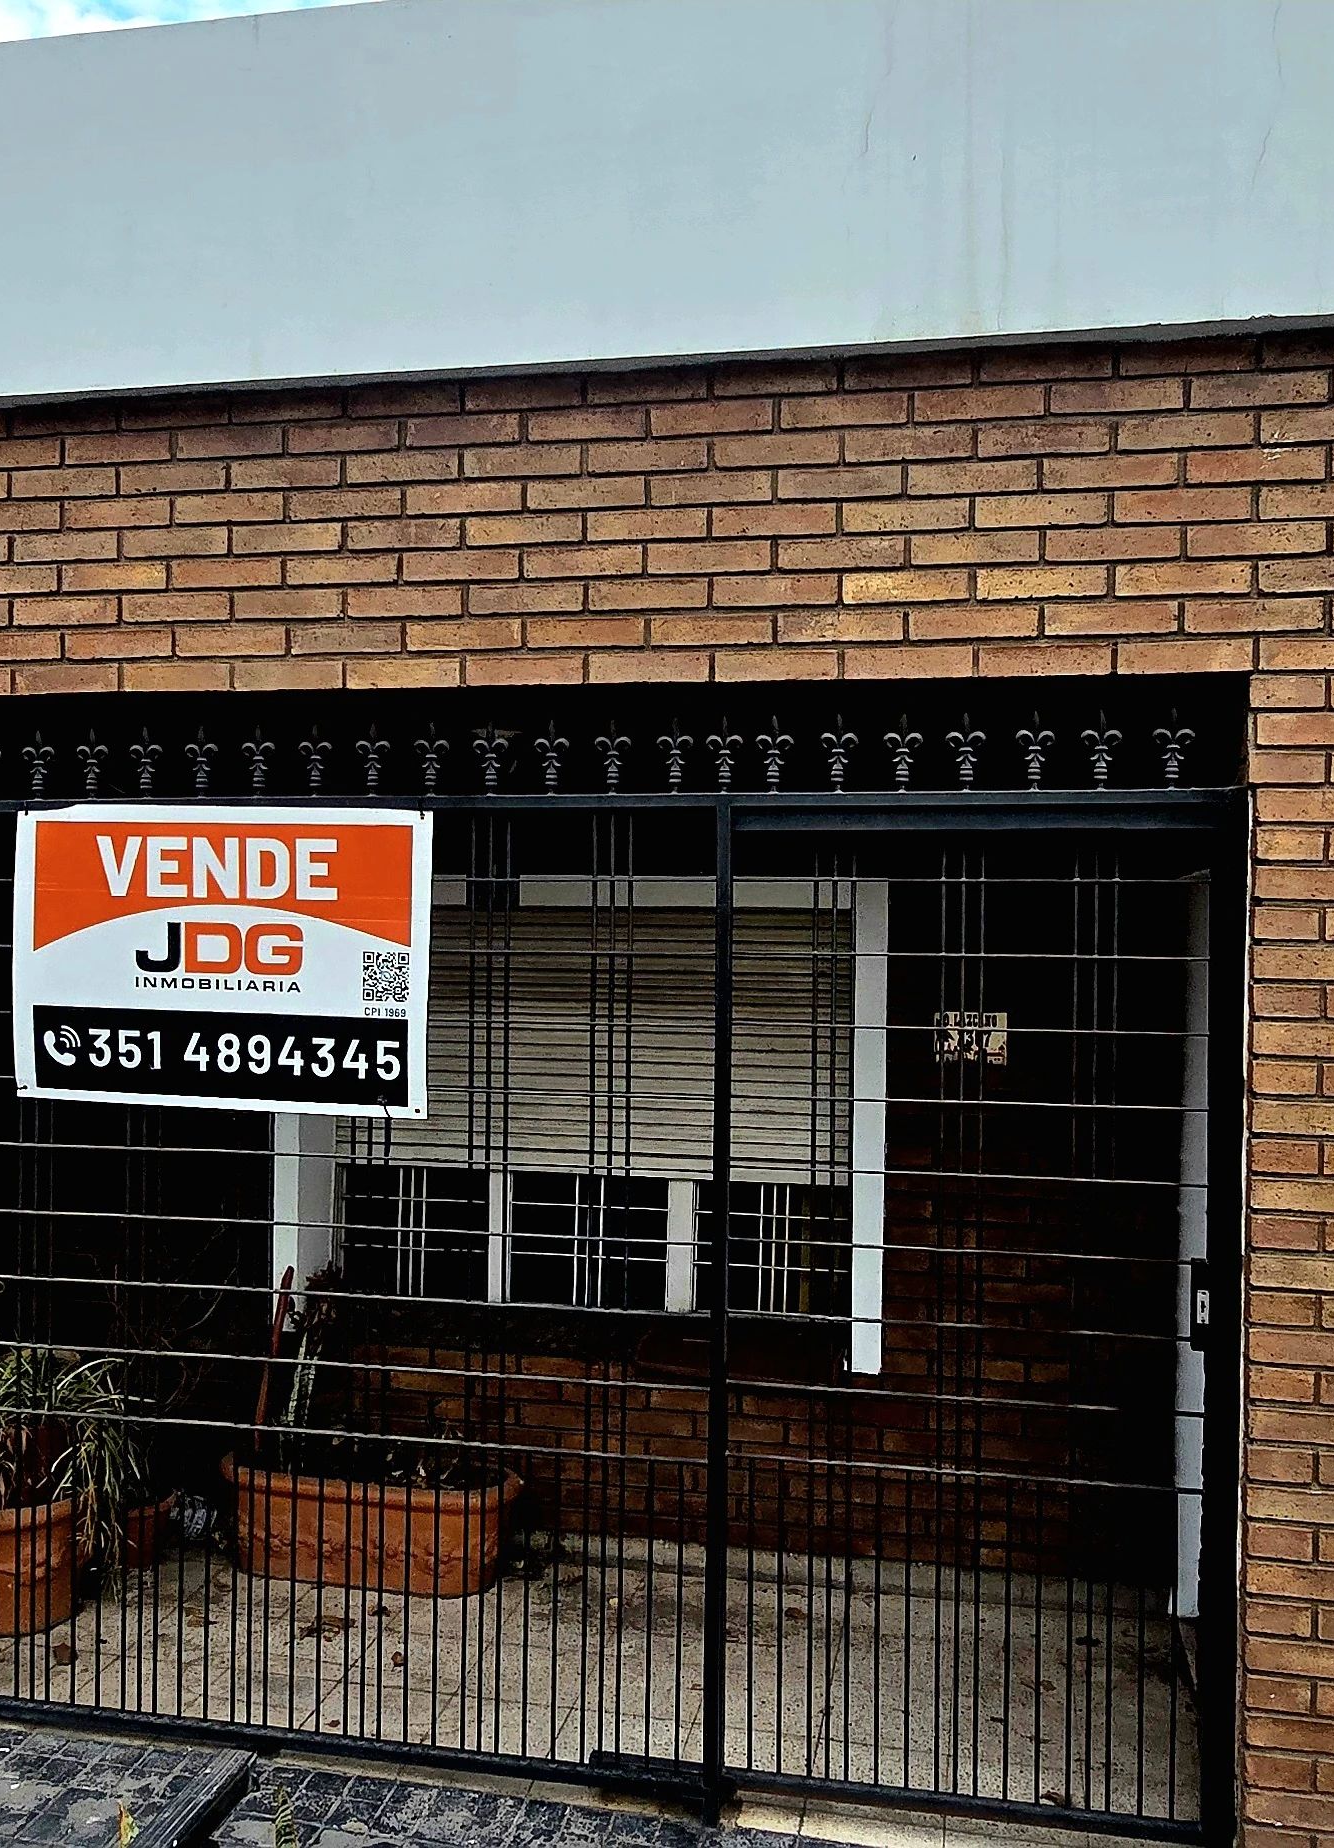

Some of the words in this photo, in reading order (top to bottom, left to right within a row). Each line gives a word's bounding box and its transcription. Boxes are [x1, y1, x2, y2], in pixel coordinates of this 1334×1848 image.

[95, 834, 338, 901] VENDE
[135, 921, 304, 976] JDG
[134, 976, 302, 993] INMOBILIARIA
[364, 1007, 381, 1017] CPI
[384, 1008, 407, 1018] 1969
[87, 1027, 162, 1071] 351
[183, 1032, 401, 1081] 4894345
